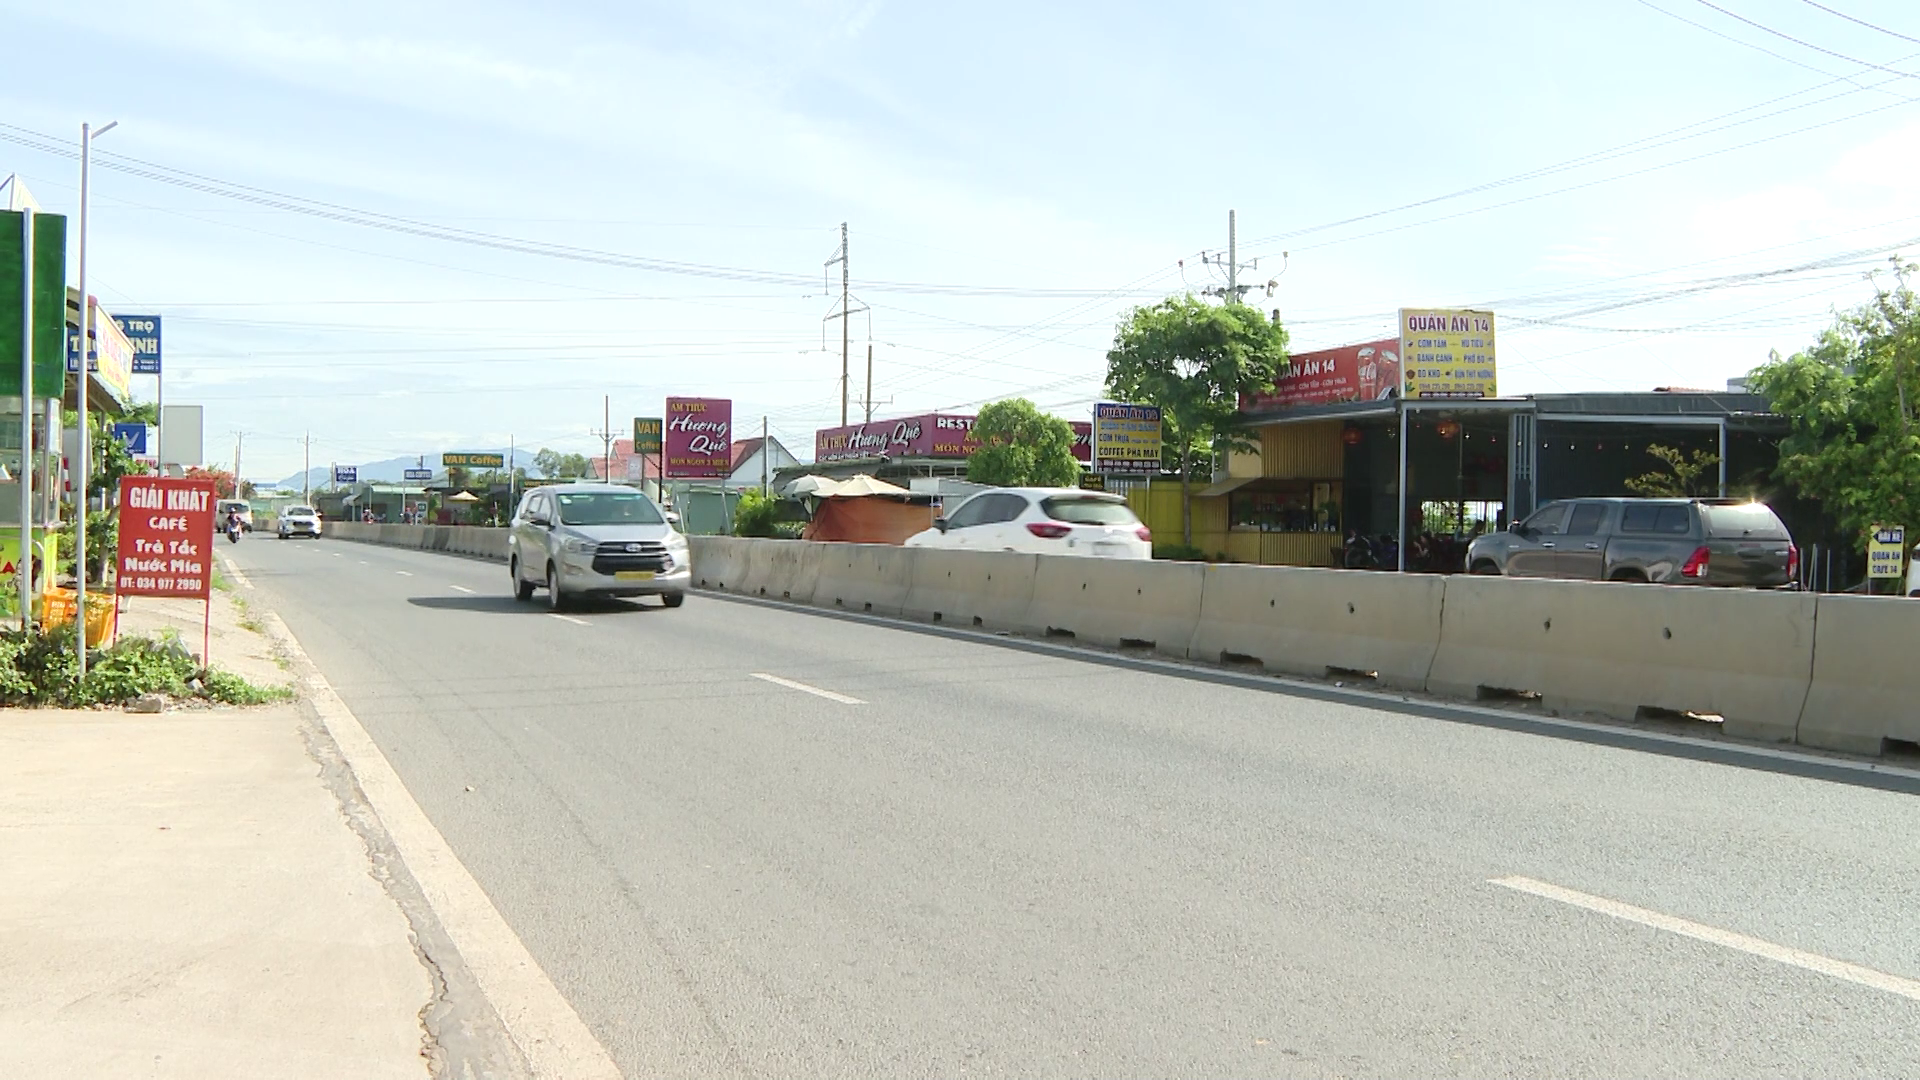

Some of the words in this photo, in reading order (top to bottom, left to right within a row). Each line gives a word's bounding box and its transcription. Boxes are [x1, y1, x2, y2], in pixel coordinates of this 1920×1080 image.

[128, 321, 154, 334] TRỌ
[1409, 313, 1446, 332] QUÁN
[1474, 319, 1488, 332] 14
[1322, 358, 1335, 373] 14
[637, 421, 660, 434] VAN
[891, 421, 921, 447] Quê
[688, 435, 727, 456] Quê
[934, 441, 960, 454] MÓN
[1099, 447, 1125, 456] COFFEE
[444, 455, 466, 465] VAN
[470, 455, 502, 465] Coffee
[130, 483, 164, 510] GIẢI
[167, 487, 210, 512] KHÁT
[149, 516, 188, 532] CAFÉ
[135, 539, 164, 554] Trà
[124, 557, 167, 572] Nước
[170, 559, 202, 574] Mía
[137, 577, 156, 590] 034
